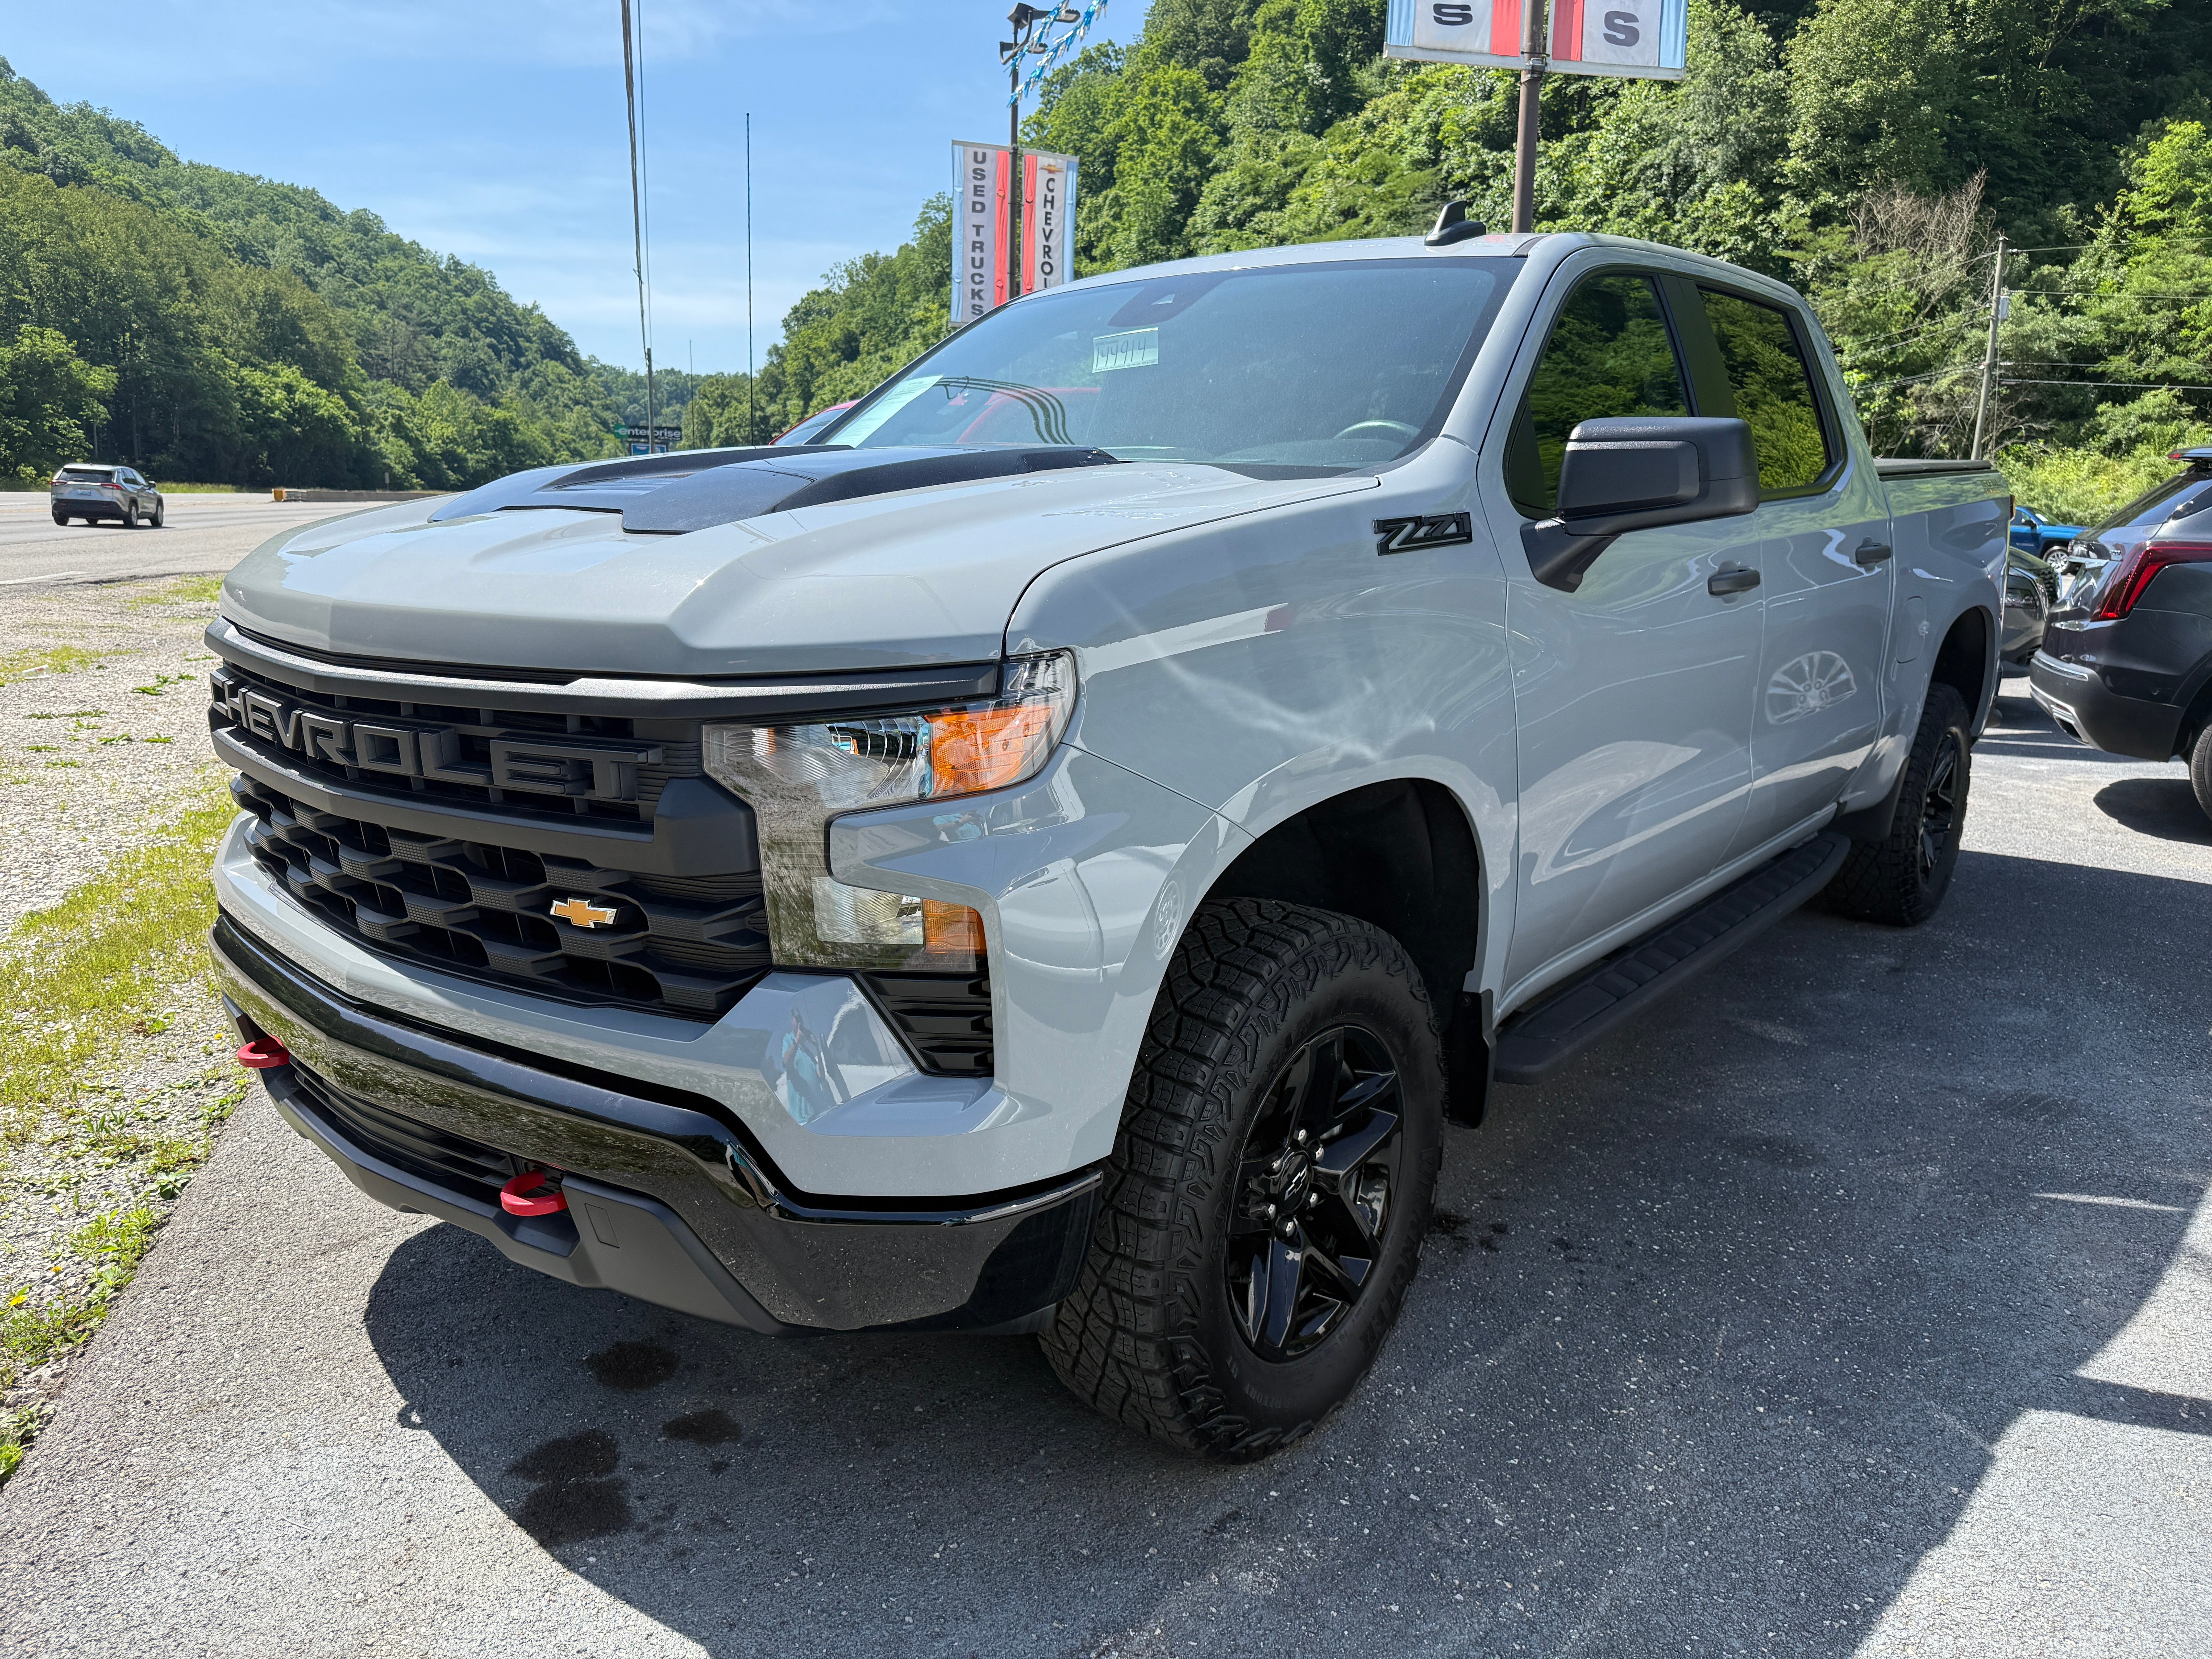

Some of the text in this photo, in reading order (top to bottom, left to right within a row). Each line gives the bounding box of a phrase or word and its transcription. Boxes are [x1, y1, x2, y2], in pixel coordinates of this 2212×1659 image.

[1433, 3, 1473, 26] S
[1603, 10, 1640, 47] S
[970, 151, 987, 316] USED TRUCKS
[1096, 337, 1146, 368] 144914
[1373, 512, 1473, 556] Z71
[210, 670, 660, 800] CHEVROLET
